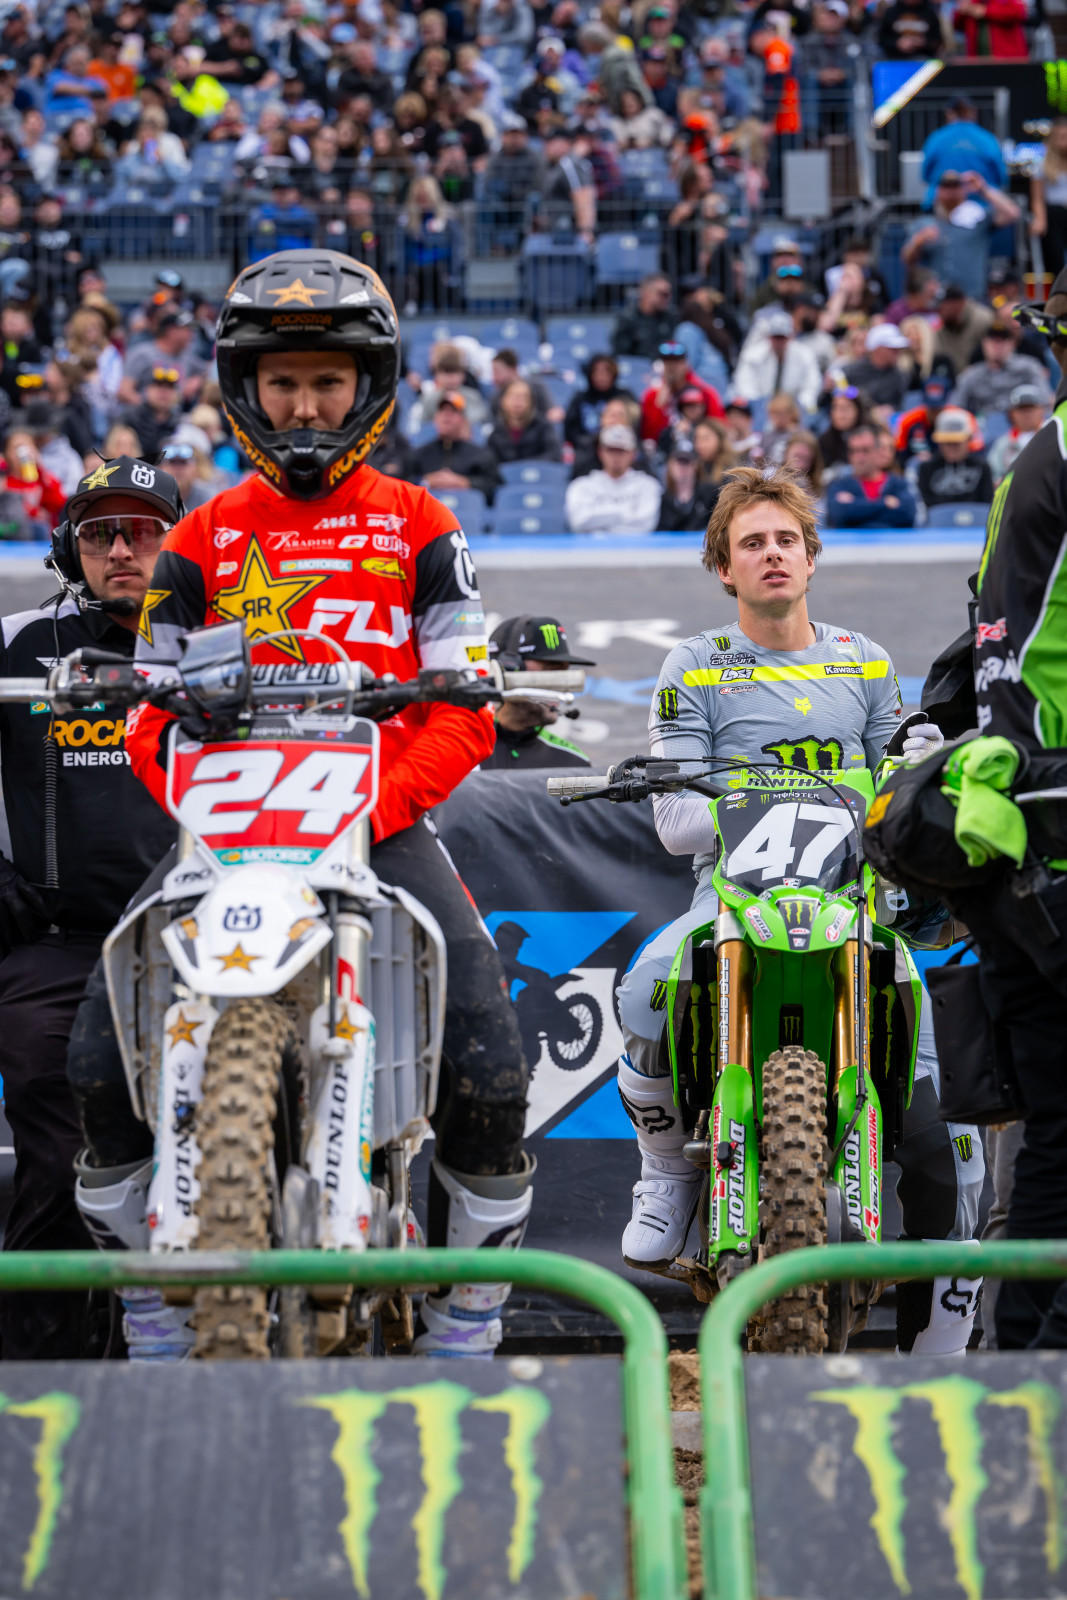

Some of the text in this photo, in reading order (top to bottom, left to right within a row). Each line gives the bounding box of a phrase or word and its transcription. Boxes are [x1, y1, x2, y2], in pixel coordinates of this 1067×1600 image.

[178, 749, 371, 836] 24
[241, 848, 313, 864] MOTOREX
[727, 802, 860, 881] 47
[174, 1088, 193, 1218] DNLOP
[323, 1063, 350, 1191] DUNLOP
[867, 1104, 878, 1171] BRAKING
